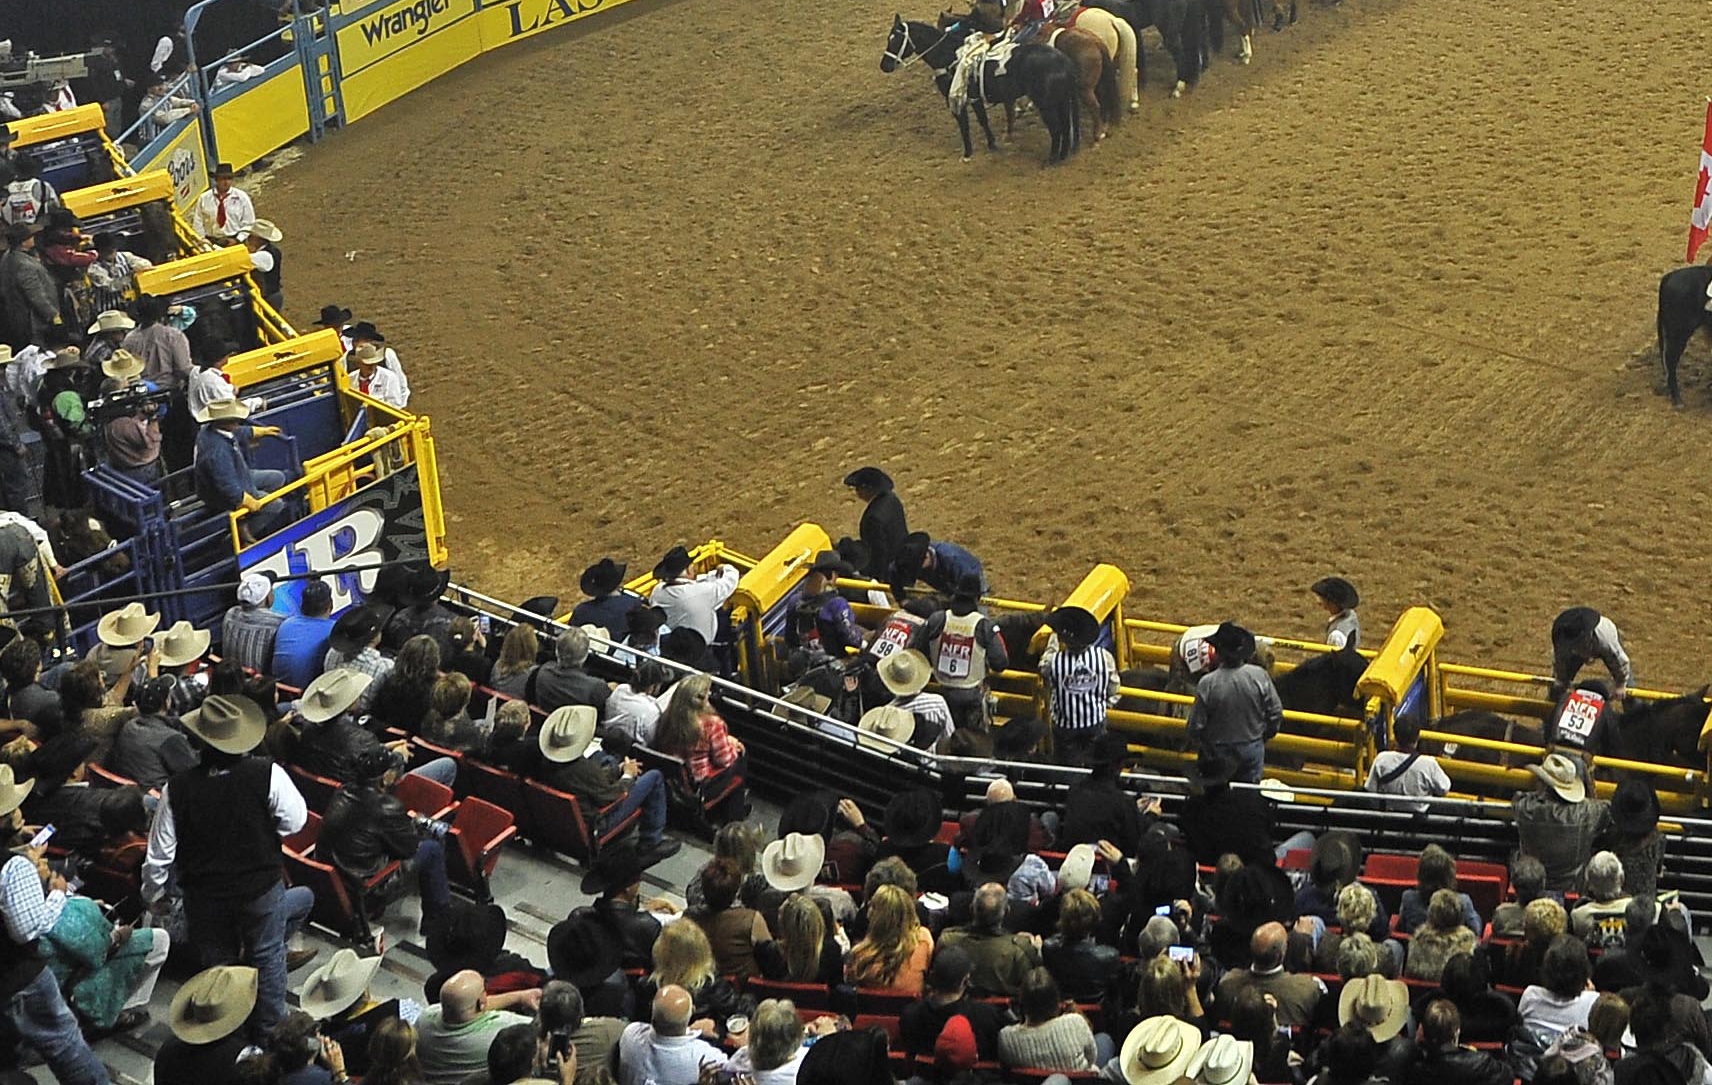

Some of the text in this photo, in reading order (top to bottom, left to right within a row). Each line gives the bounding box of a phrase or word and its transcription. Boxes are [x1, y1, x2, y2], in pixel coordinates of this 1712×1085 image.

[882, 627, 909, 647] NFR
[942, 642, 972, 660] NFR
[949, 659, 958, 673] 6
[1567, 698, 1599, 719] NFR
[1568, 714, 1585, 730] 53
